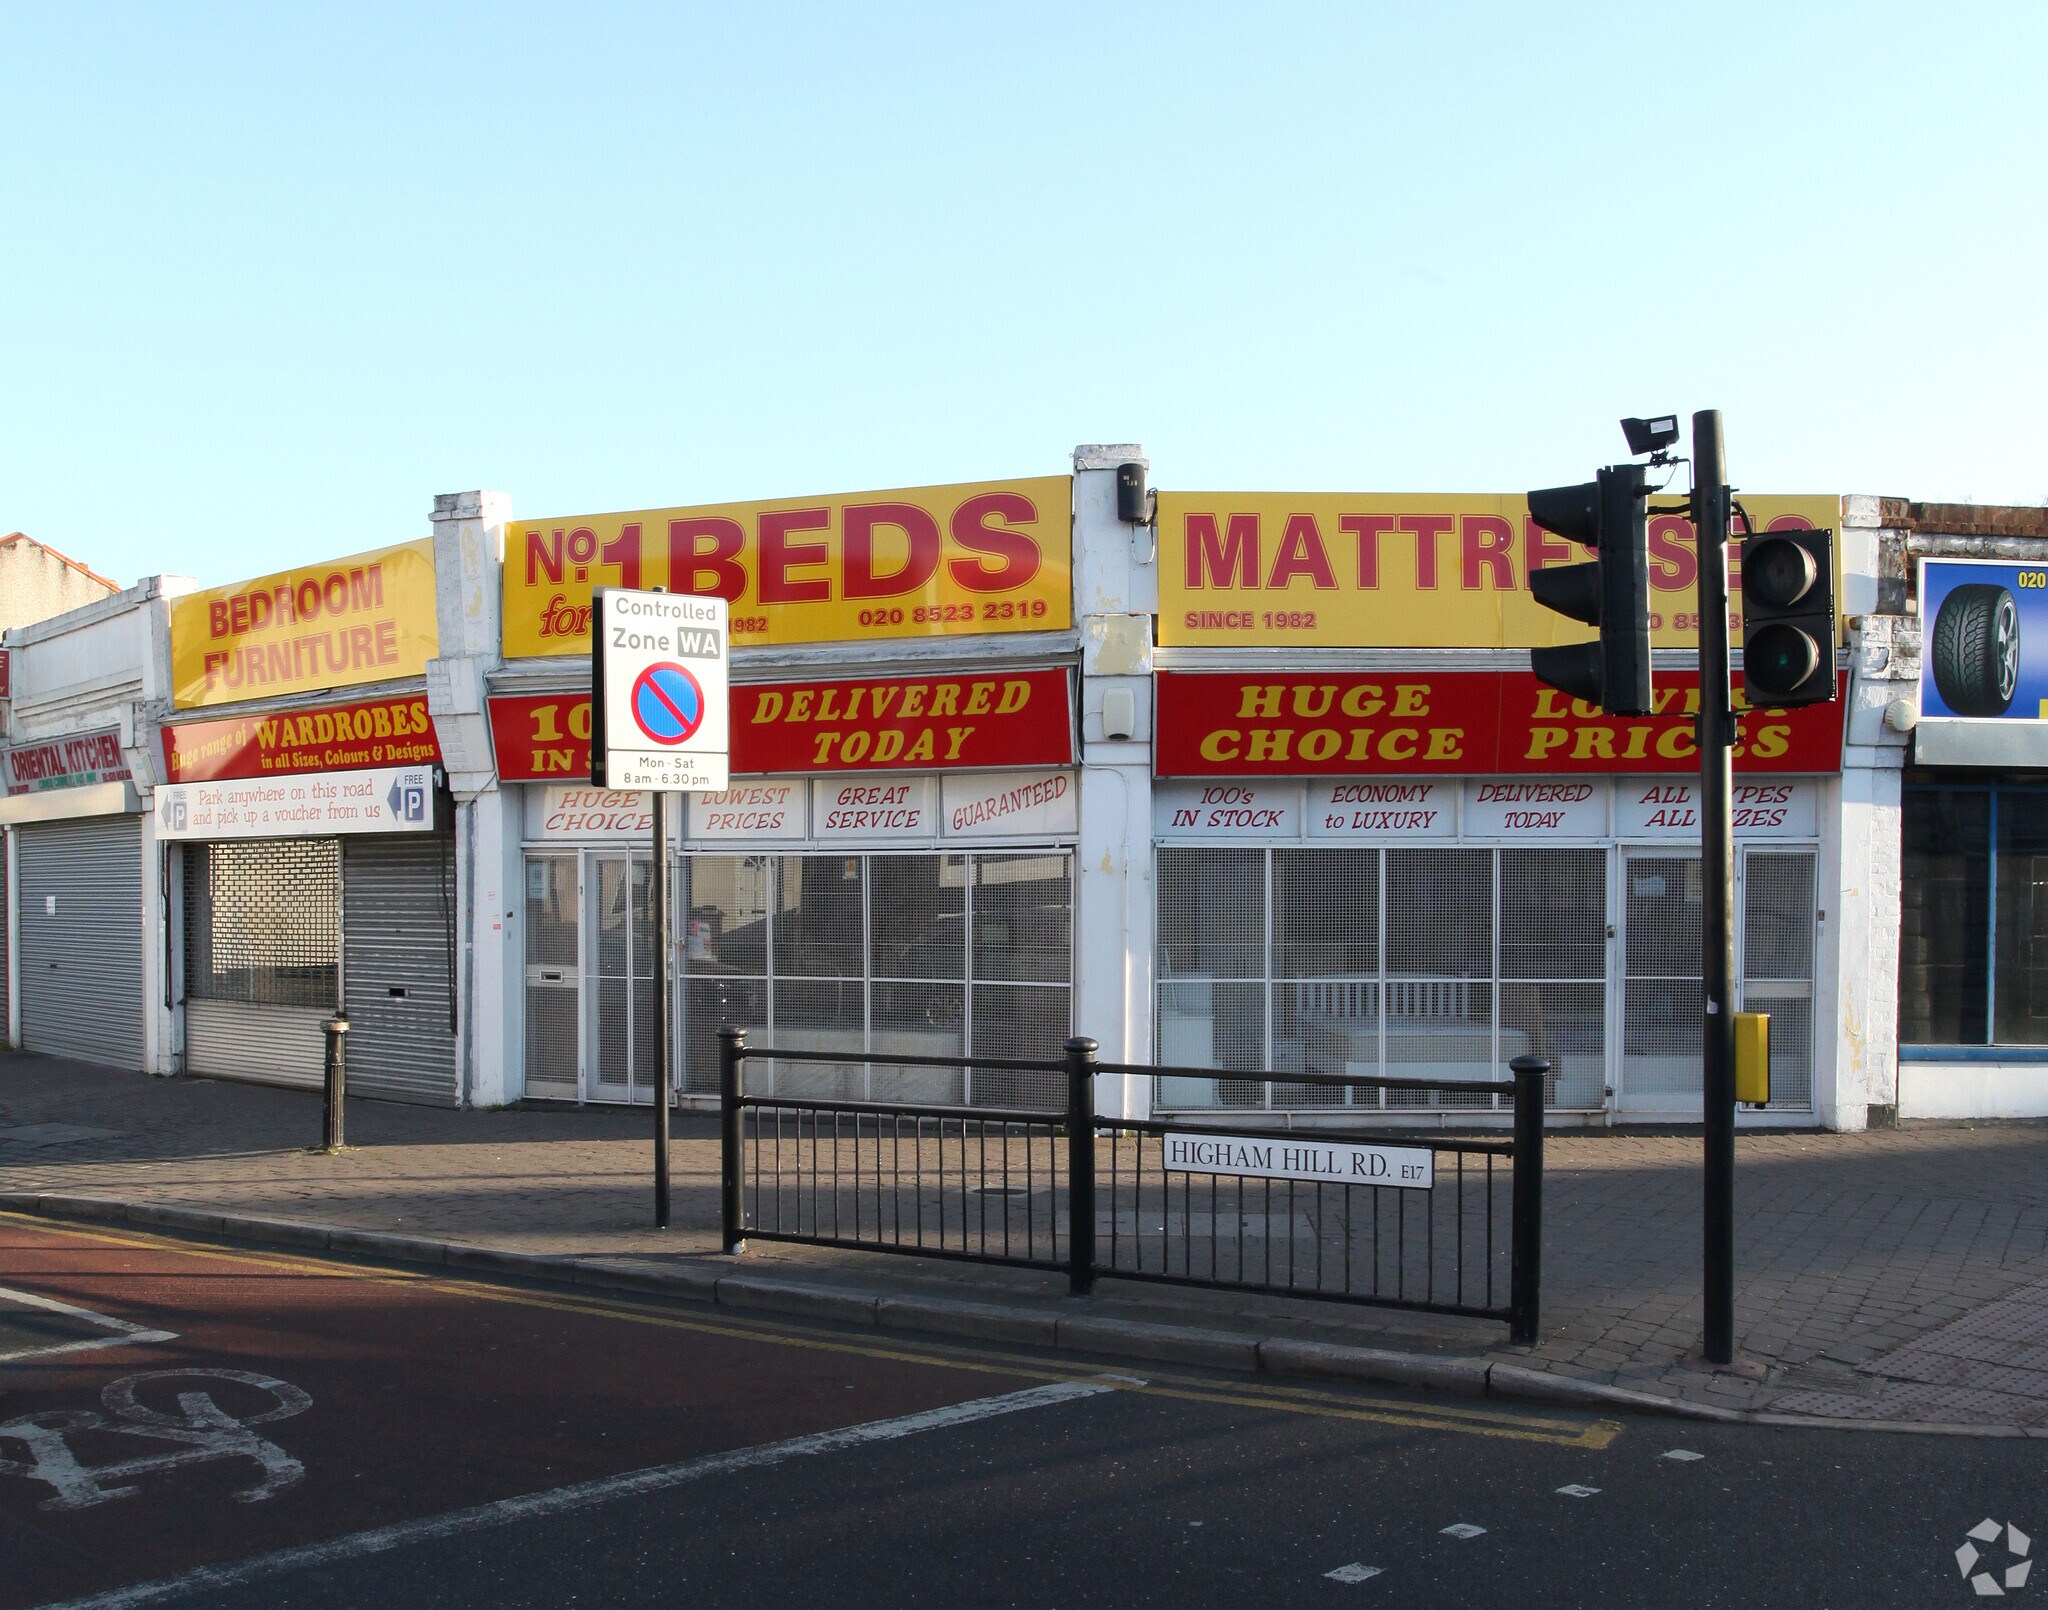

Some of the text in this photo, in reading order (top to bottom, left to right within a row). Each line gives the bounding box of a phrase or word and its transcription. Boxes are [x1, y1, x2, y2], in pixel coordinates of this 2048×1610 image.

[668, 491, 1042, 606] BEDS
[2018, 571, 2047, 589] 020
[210, 563, 384, 640] BEDROOM
[616, 597, 716, 621] Controlled
[858, 599, 1047, 627] 020 8523 2319
[1184, 610, 1317, 629] SINCE 1982
[613, 627, 719, 655] Zone WA
[204, 618, 399, 693] FURNITURE
[750, 680, 1031, 723] DELIVERED
[1236, 684, 1432, 718] HUGE
[253, 702, 429, 750] WARDROBES
[171, 722, 247, 772] Huge range of
[261, 741, 435, 769] in all Sizes, Colours & Designs
[813, 727, 976, 763] TODAY
[1200, 728, 1465, 761] CHOICE
[10, 744, 67, 782] ORIENTAL
[65, 734, 122, 772] KITCHEN
[530, 748, 575, 772] IN
[640, 757, 664, 768] Mon
[675, 758, 694, 769] Sat
[404, 774, 424, 785] FREE
[624, 773, 631, 784] 8
[634, 775, 652, 784] am
[661, 774, 690, 785] 6.30
[692, 776, 709, 786] pm
[173, 791, 187, 800] FREE
[199, 778, 374, 808] Park anywhere on this road
[559, 790, 642, 809] HUGE
[701, 787, 790, 805] LOWEST
[837, 786, 910, 806] GREAT
[952, 775, 1068, 831] GUARANTEED
[1331, 784, 1434, 804] ECONOMY
[1477, 784, 1593, 803] DELIVERED
[1640, 786, 1691, 804] ALL
[193, 801, 381, 829] and pick up a voucher from us
[545, 812, 655, 831] CHOICE
[706, 812, 785, 830] PRICES
[826, 809, 921, 830] SERVICE
[1172, 810, 1285, 828] IN STOCK
[1325, 811, 1438, 830] to LUXURY
[1504, 811, 1566, 829] TODAY
[1645, 809, 1696, 827] ALL
[1171, 1140, 1424, 1180] HIGHAM HILL RD. E17
